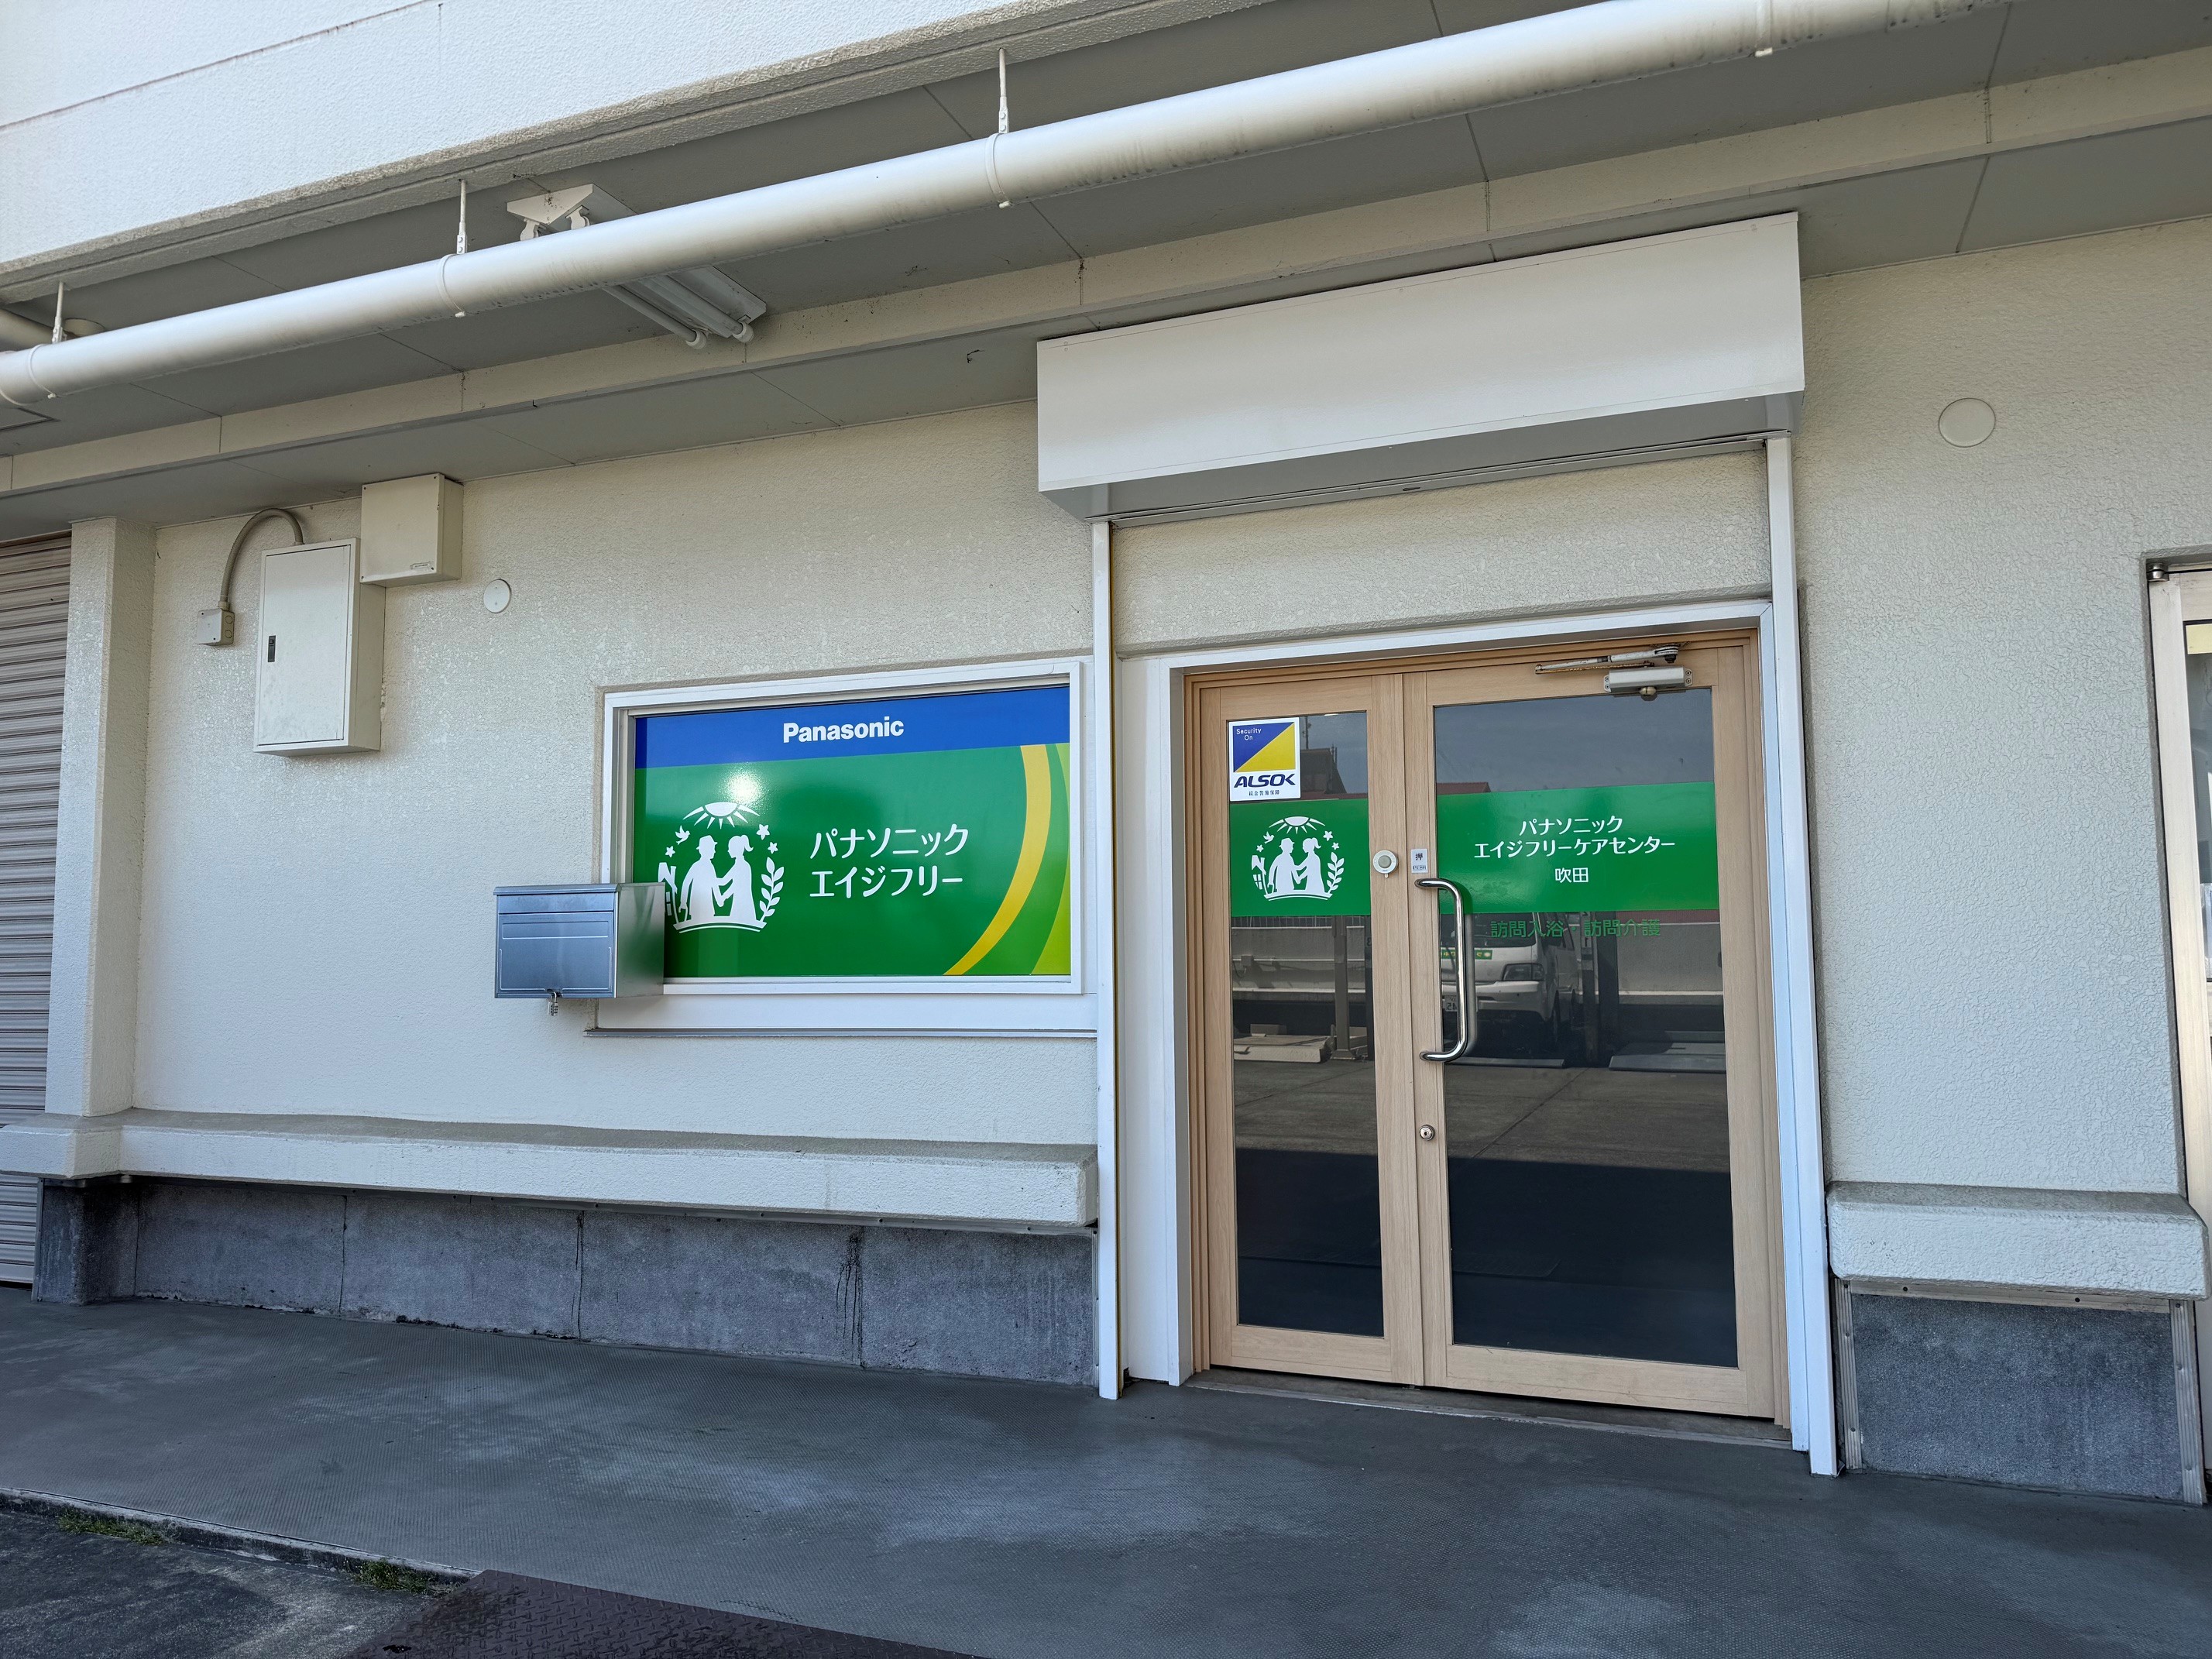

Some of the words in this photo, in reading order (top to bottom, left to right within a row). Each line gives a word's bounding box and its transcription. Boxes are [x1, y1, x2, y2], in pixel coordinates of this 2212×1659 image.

[783, 716, 905, 744] Panasonic
[1233, 773, 1296, 788] ALSOK
[1519, 815, 1623, 836] パナソニック
[810, 823, 969, 859] パナソニック
[1474, 836, 1675, 859] エイジフリーケアセンター
[809, 864, 963, 898] エイジフリー
[1554, 867, 1589, 883] 吹田
[1490, 919, 1661, 938] 訪問入浴・訪問介護
